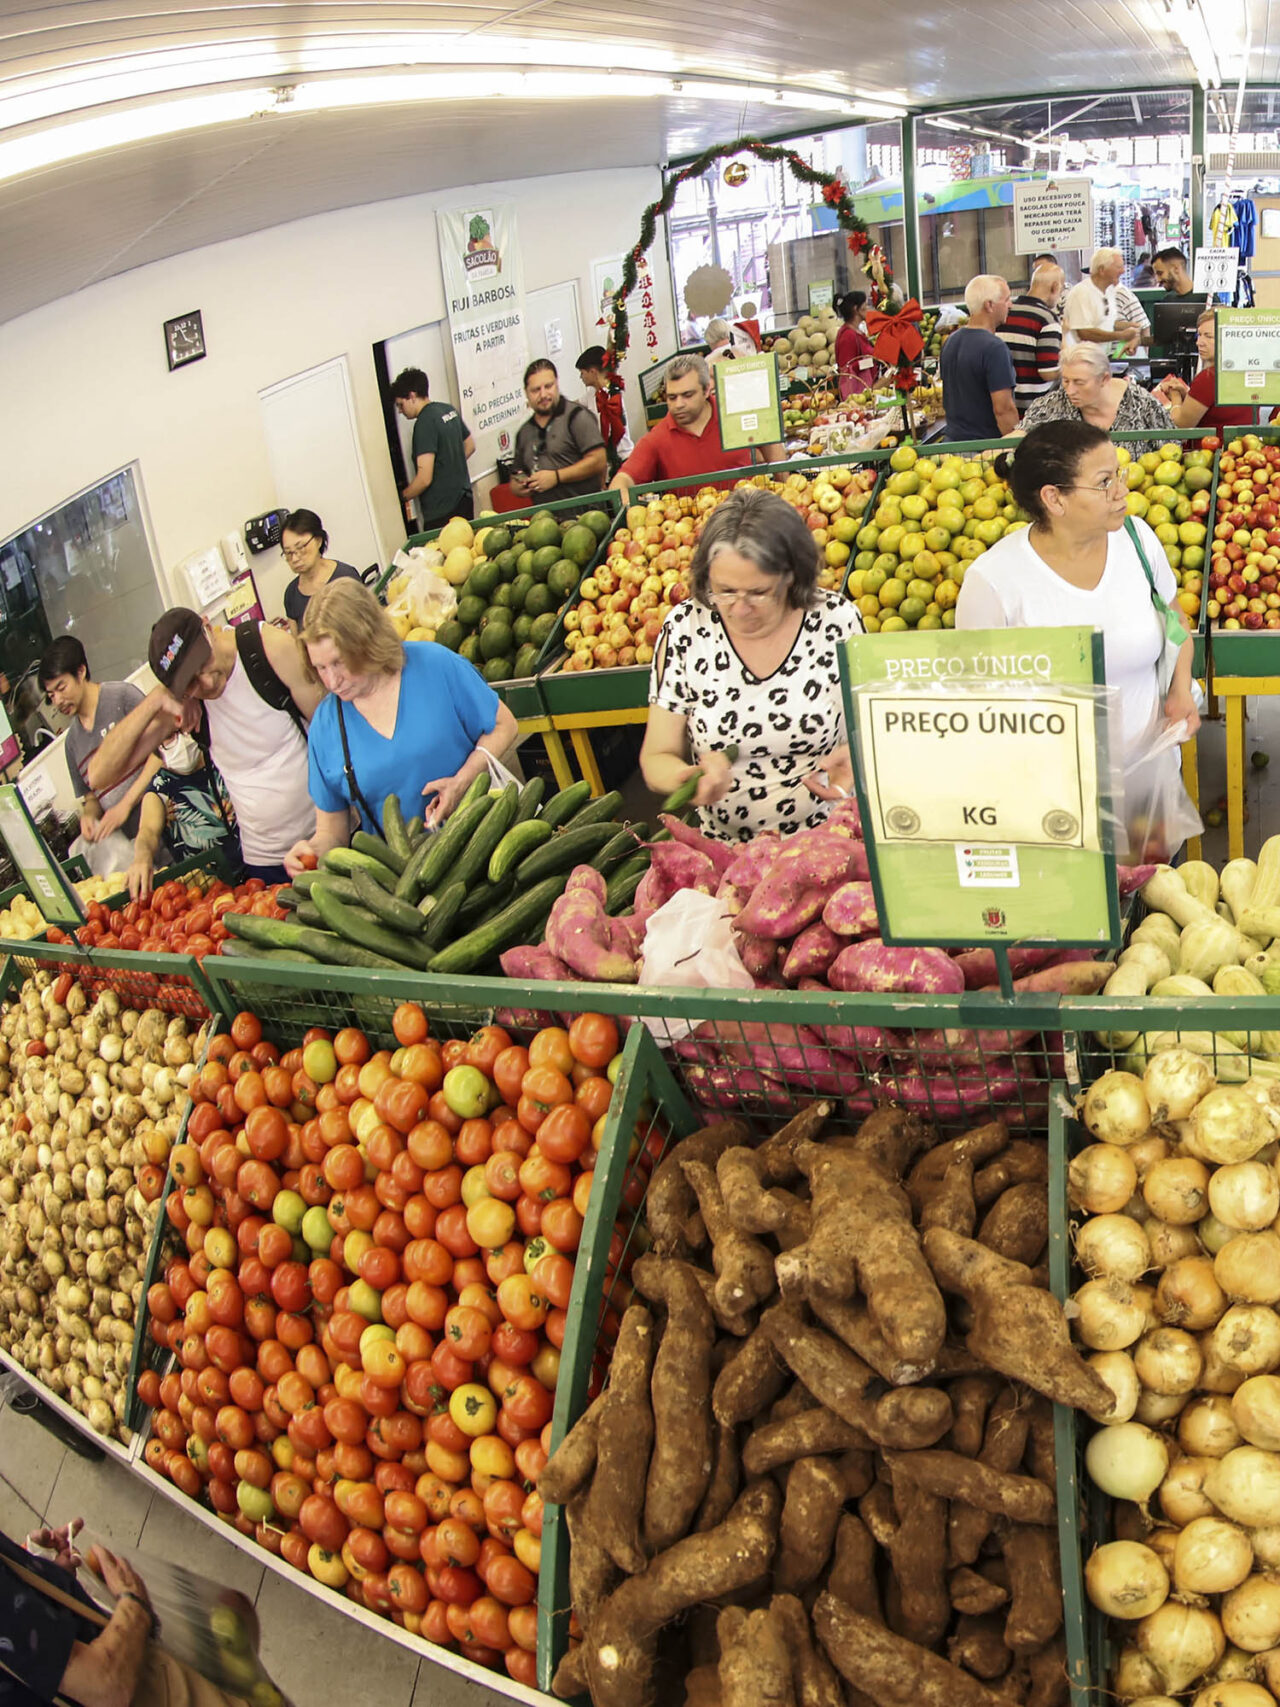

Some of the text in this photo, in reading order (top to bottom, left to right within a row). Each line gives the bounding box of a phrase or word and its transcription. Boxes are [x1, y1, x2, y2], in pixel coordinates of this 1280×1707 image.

[1038, 193, 1072, 201] EXCESSIVO
[1020, 204, 1048, 212] SACOLAS
[1024, 210, 1064, 219] MERCADORIA
[466, 251, 497, 268] SACOLÃO
[452, 285, 515, 313] RUI BARBOSA
[453, 314, 520, 344] FRUTAS E VERDURAS
[1225, 330, 1253, 339] PREÇO
[475, 334, 506, 353] A PARTIR
[1248, 358, 1260, 366] KG
[462, 386, 473, 399] R$
[472, 388, 523, 416] NÃO PRECISA DE
[885, 652, 1052, 681] PREÇO ÚNICO
[885, 706, 1065, 738] PREÇO ÚNICO
[962, 806, 998, 826] KG
